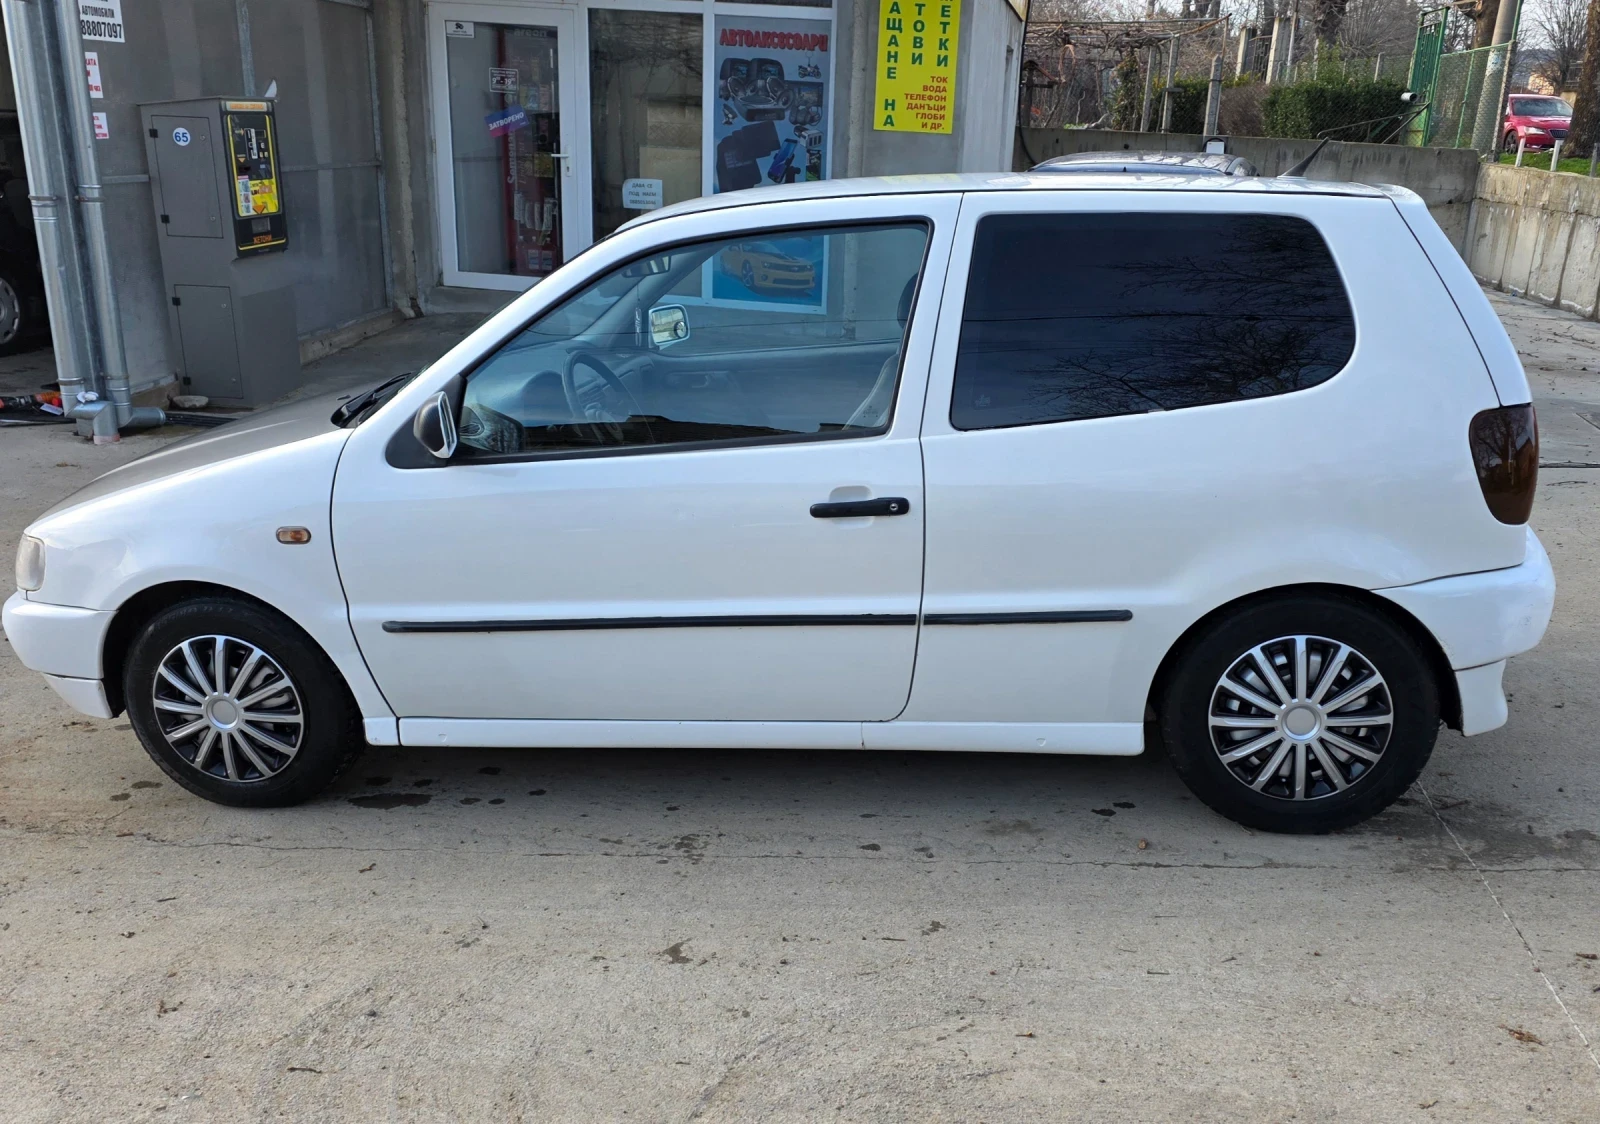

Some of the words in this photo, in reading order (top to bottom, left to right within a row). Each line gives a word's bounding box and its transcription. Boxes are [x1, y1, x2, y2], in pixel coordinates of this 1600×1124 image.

[911, 3, 926, 66] ТОВИ
[936, 0, 953, 67] ЕТКИ
[922, 85, 947, 93] ВОДА
[904, 93, 947, 102] ТЕЛЕФОН
[883, 98, 896, 127] НА
[906, 103, 946, 112] ДАНЪЦИ
[489, 111, 525, 130] ЗАТВОРЕНО
[915, 112, 945, 120] ГЛОБИ
[929, 123, 945, 131] ДР.
[174, 132, 189, 143] 65
